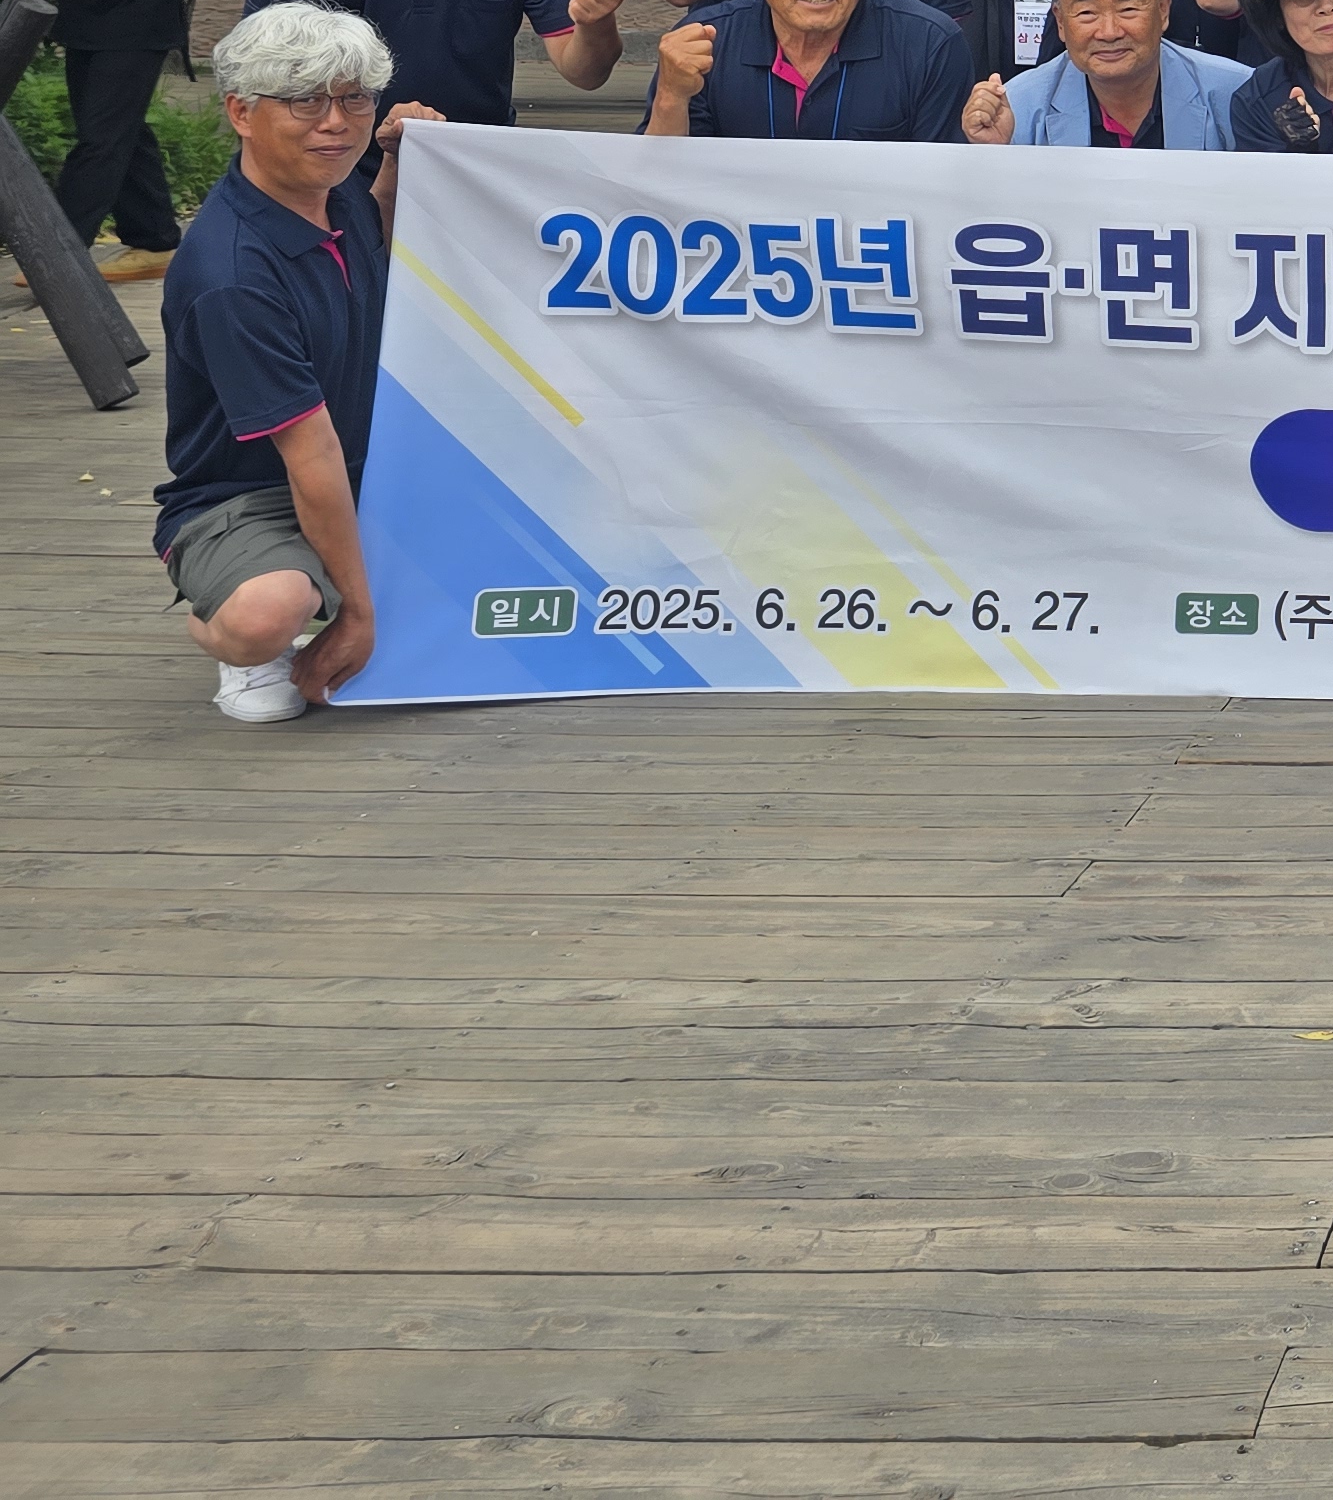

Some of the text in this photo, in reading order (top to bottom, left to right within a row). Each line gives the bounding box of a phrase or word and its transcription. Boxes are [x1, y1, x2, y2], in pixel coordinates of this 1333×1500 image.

[540, 211, 917, 331] 2025년
[950, 222, 1194, 345] 읍·면
[600, 588, 734, 633] 2025.
[755, 587, 797, 632] 6.
[817, 587, 888, 633] 26.
[970, 589, 1012, 634] 6.
[1031, 590, 1100, 635] 27.
